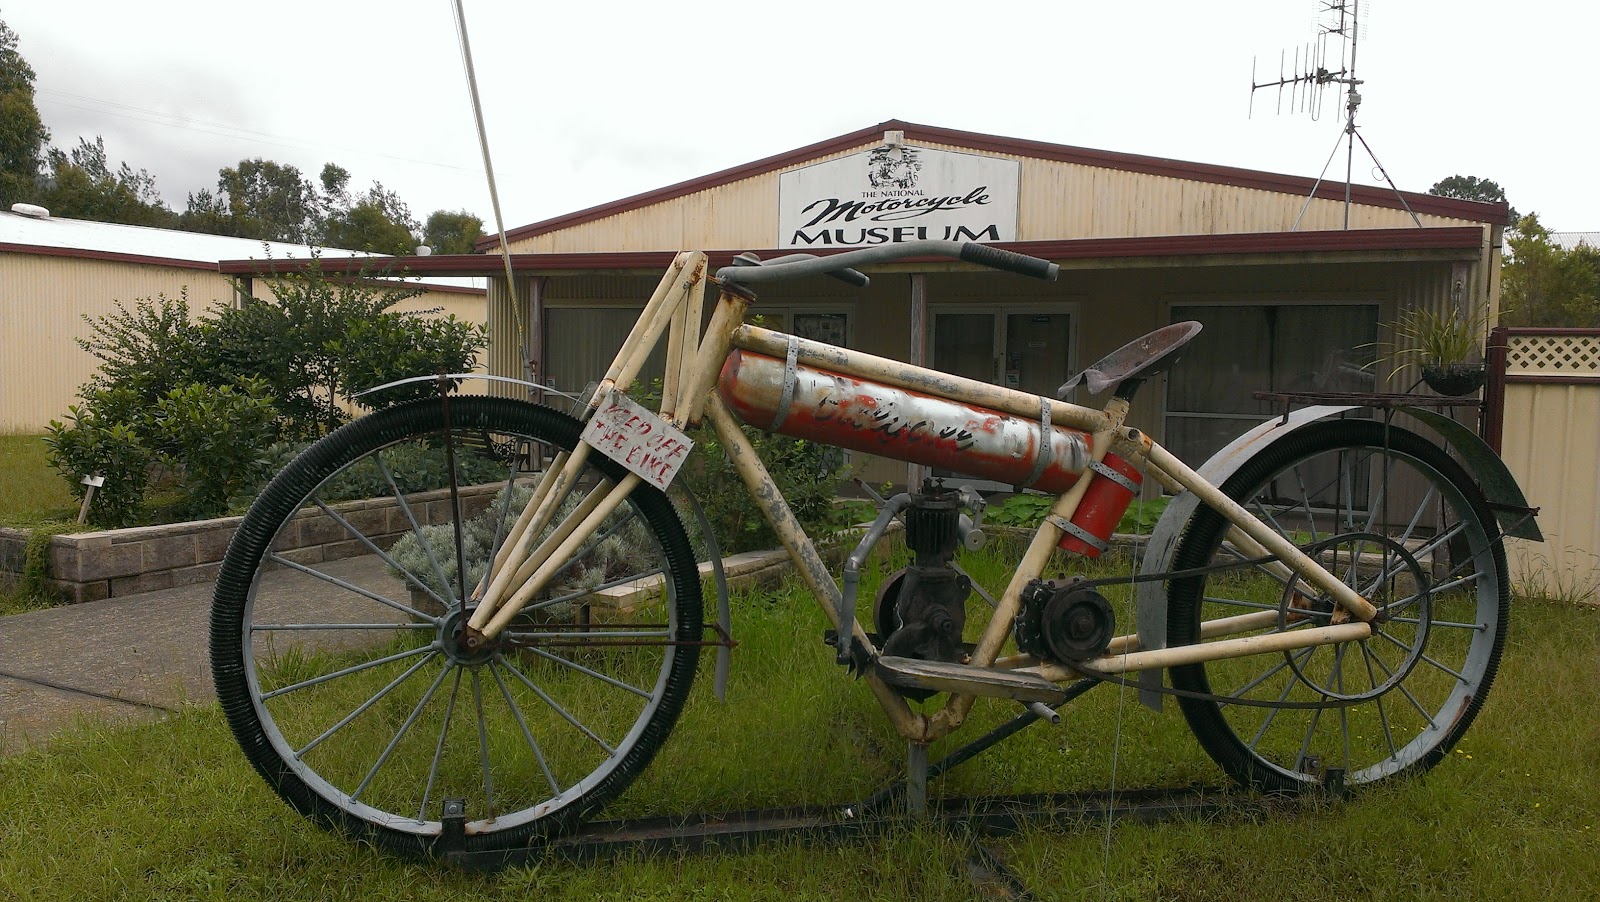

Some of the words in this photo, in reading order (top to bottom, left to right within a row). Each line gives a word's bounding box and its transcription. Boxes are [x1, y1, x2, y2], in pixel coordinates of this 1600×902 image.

[881, 189, 925, 197] NATIONAL
[801, 185, 992, 229] Motorcycle
[790, 224, 1000, 245] MUSEUM
